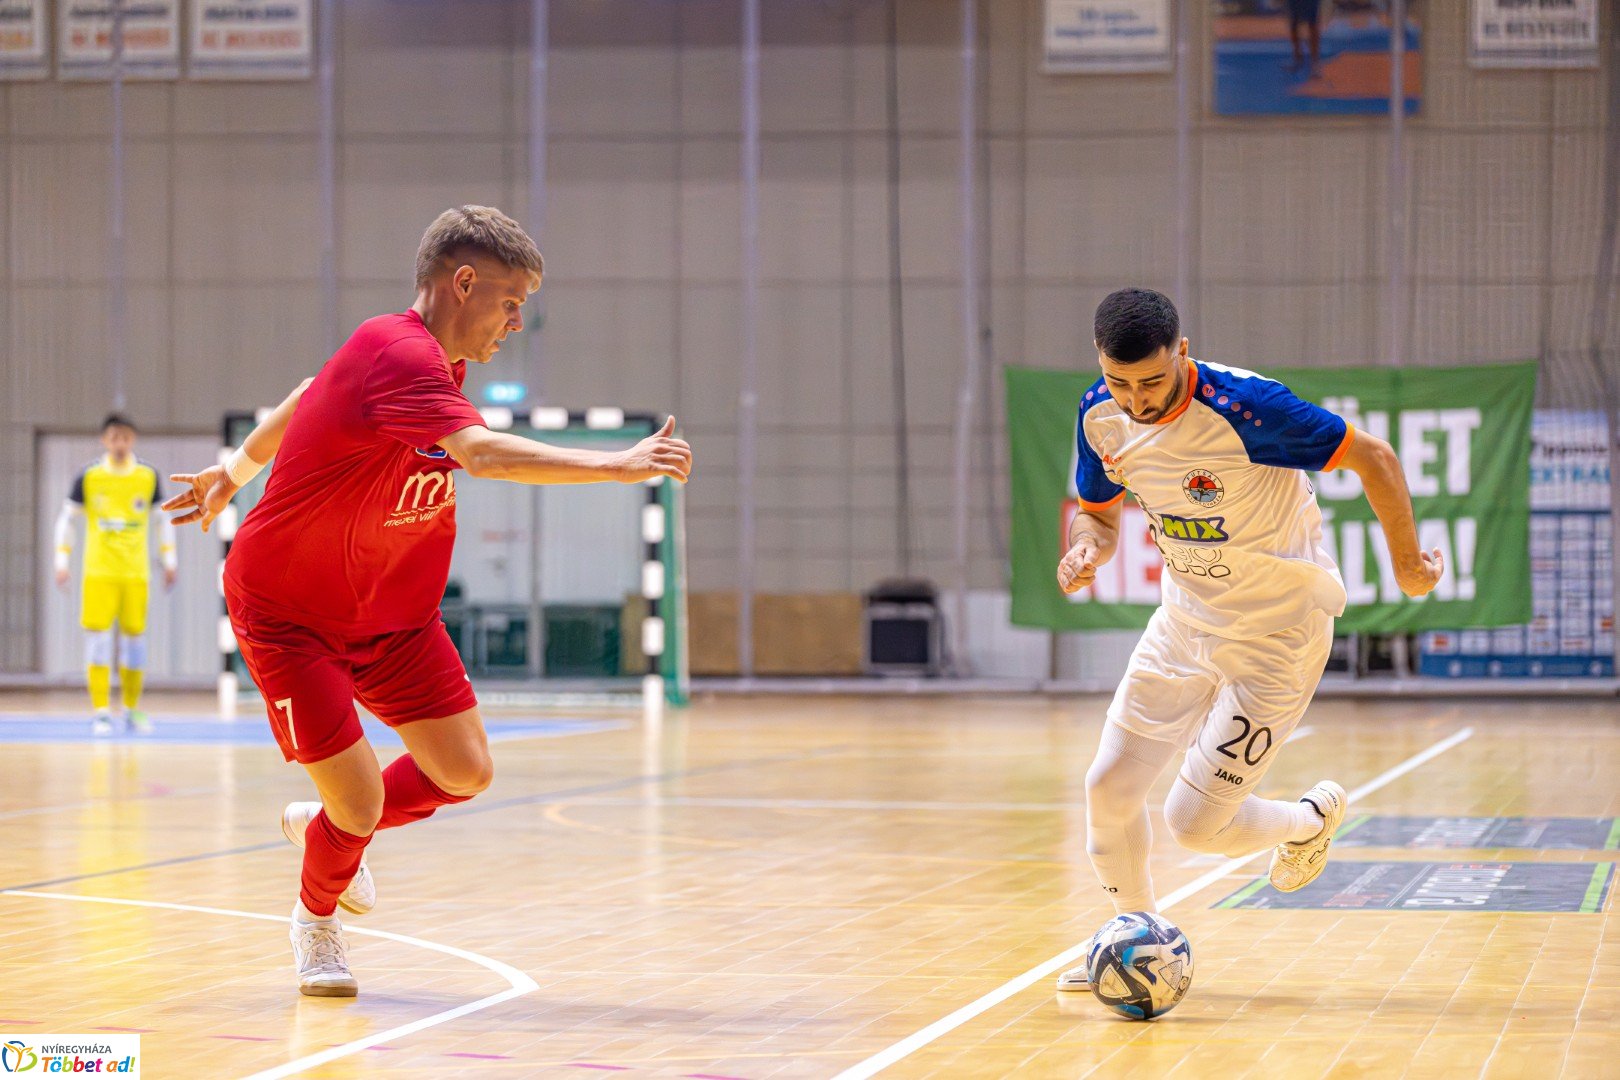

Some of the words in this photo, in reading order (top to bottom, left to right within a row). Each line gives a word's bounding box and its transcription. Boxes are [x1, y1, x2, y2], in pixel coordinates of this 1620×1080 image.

[274, 697, 299, 750] 7
[1215, 715, 1272, 766] 20
[1214, 768, 1243, 785] JAKO
